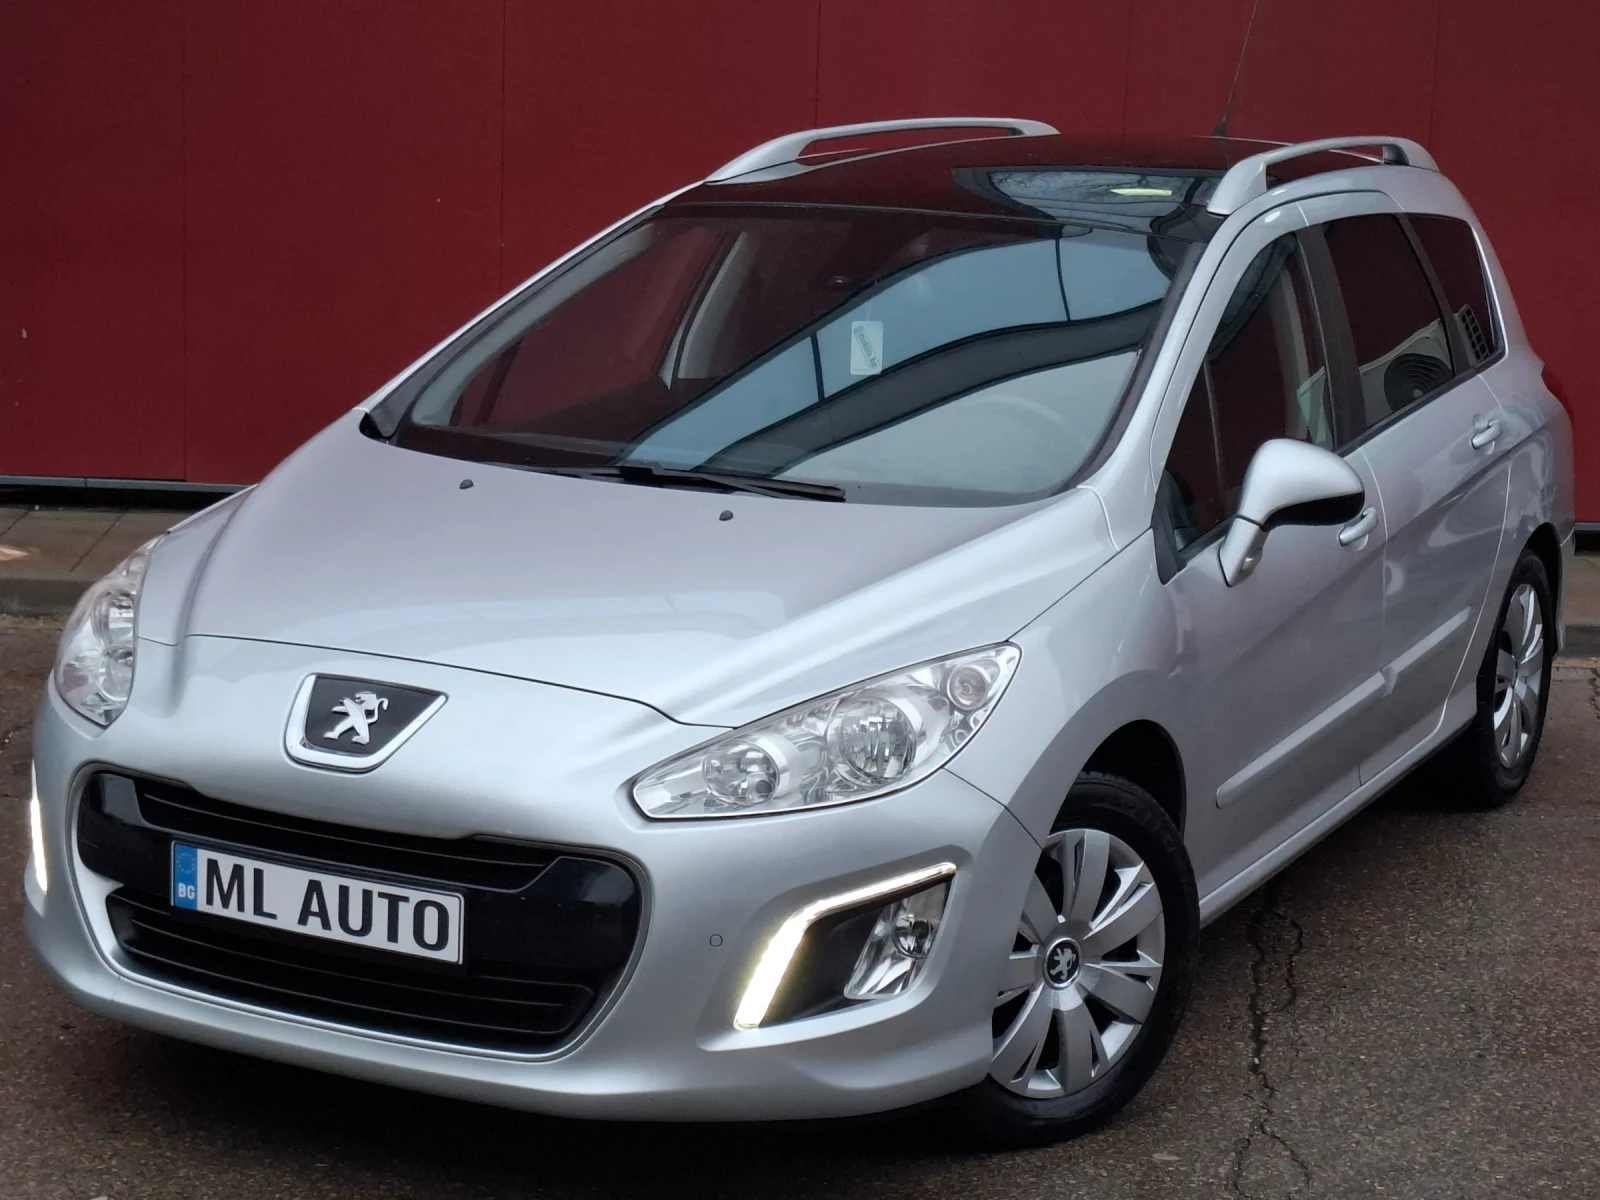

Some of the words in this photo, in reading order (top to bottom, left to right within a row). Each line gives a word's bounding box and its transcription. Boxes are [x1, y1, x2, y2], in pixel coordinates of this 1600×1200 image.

[178, 882, 196, 900] BG
[206, 858, 277, 920] ML
[297, 879, 450, 951] AUTO
